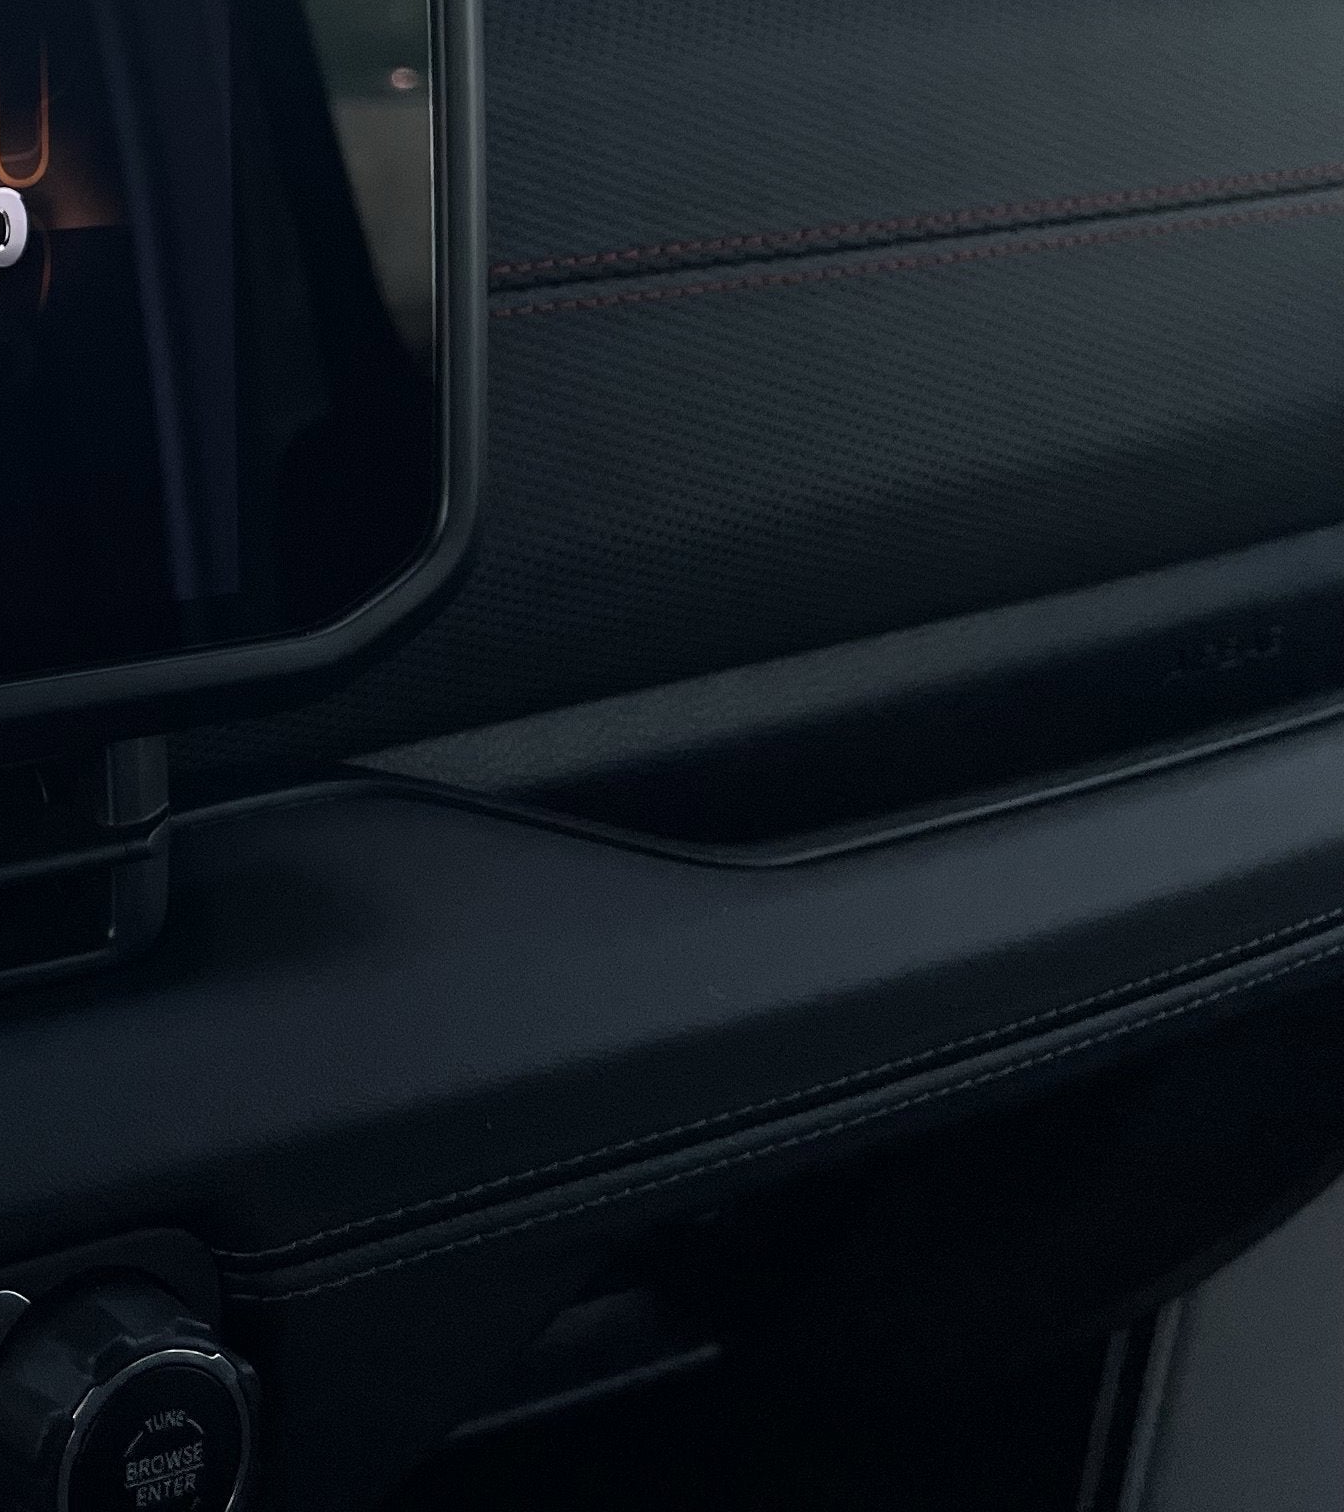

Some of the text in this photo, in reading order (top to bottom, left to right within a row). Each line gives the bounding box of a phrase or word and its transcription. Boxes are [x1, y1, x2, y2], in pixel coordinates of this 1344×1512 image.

[145, 1409, 186, 1433] TUNE
[125, 1440, 204, 1482] BROWSE
[136, 1473, 198, 1507] ENTER
